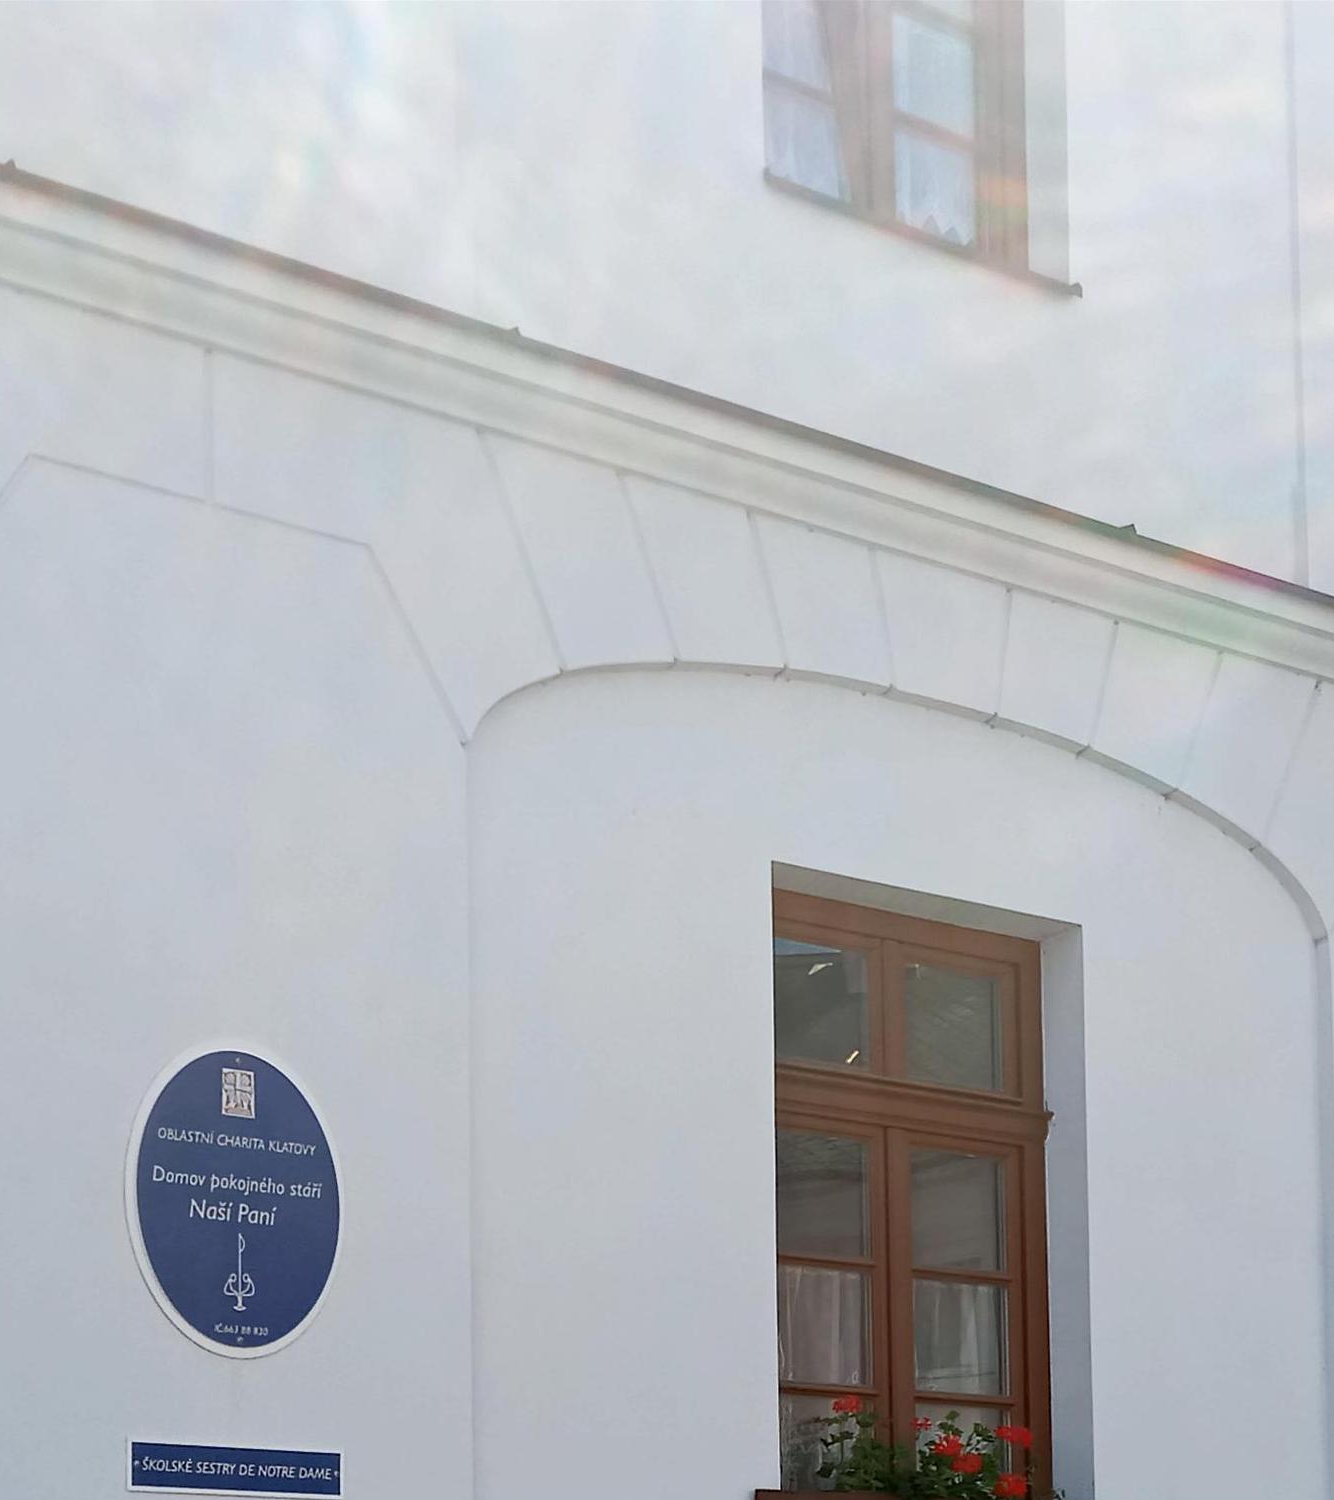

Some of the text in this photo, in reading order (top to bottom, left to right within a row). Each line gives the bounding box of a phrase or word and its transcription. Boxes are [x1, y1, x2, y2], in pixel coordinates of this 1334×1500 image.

[158, 1127, 316, 1156] OBLASTNÍ CHARITA KLATOVY
[152, 1165, 323, 1199] Domov pokojného stáří
[189, 1198, 277, 1225] Naší Paní
[142, 1457, 332, 1480] ŠKOLSKÉ SESTRY DE NOTRE DAME
